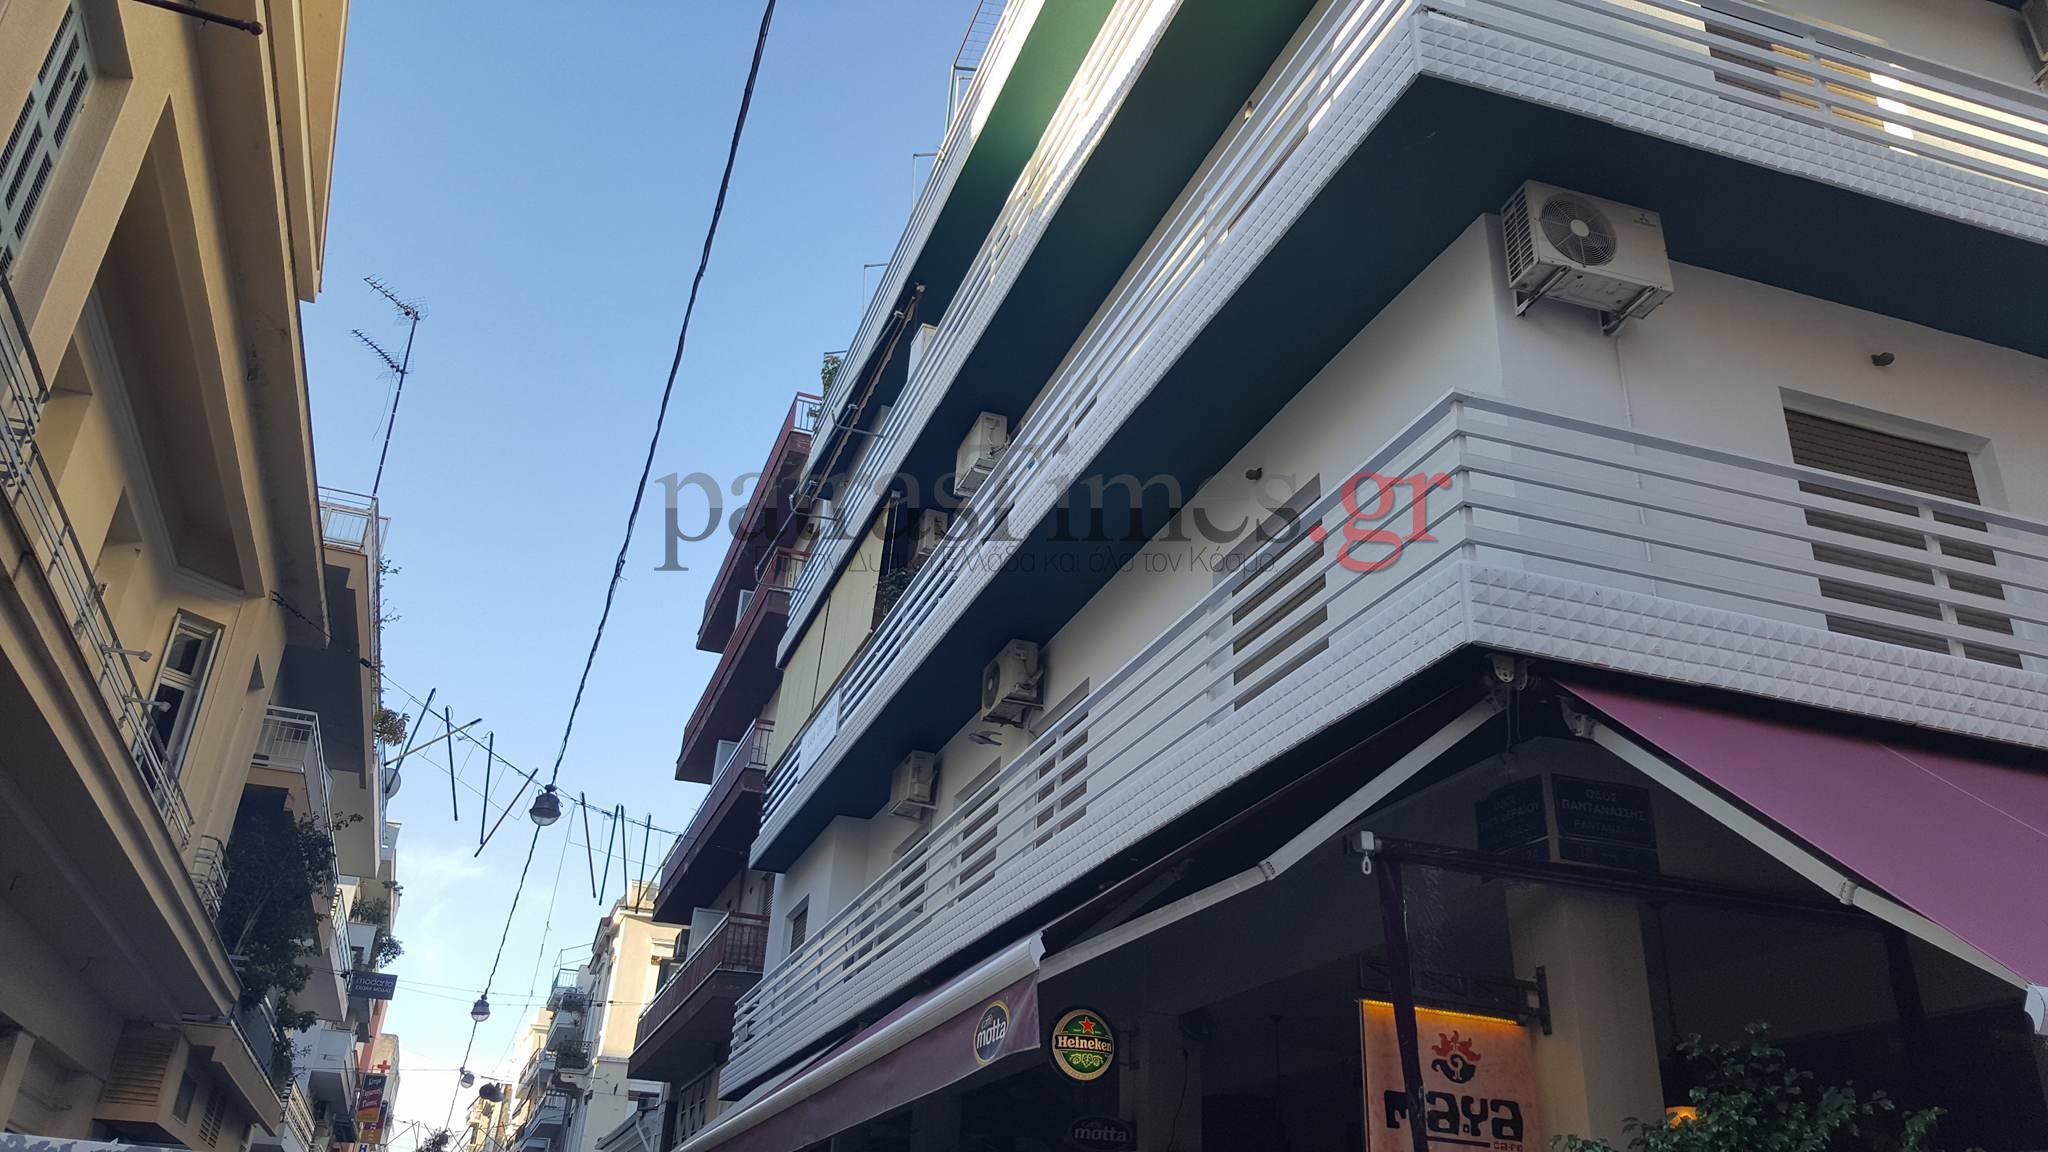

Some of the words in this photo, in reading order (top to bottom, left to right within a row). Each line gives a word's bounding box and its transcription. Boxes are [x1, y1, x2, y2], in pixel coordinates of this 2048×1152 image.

[976, 1016, 1007, 1049] motta
[1057, 1035, 1112, 1053] Heineken
[1074, 1125, 1127, 1143] motta
